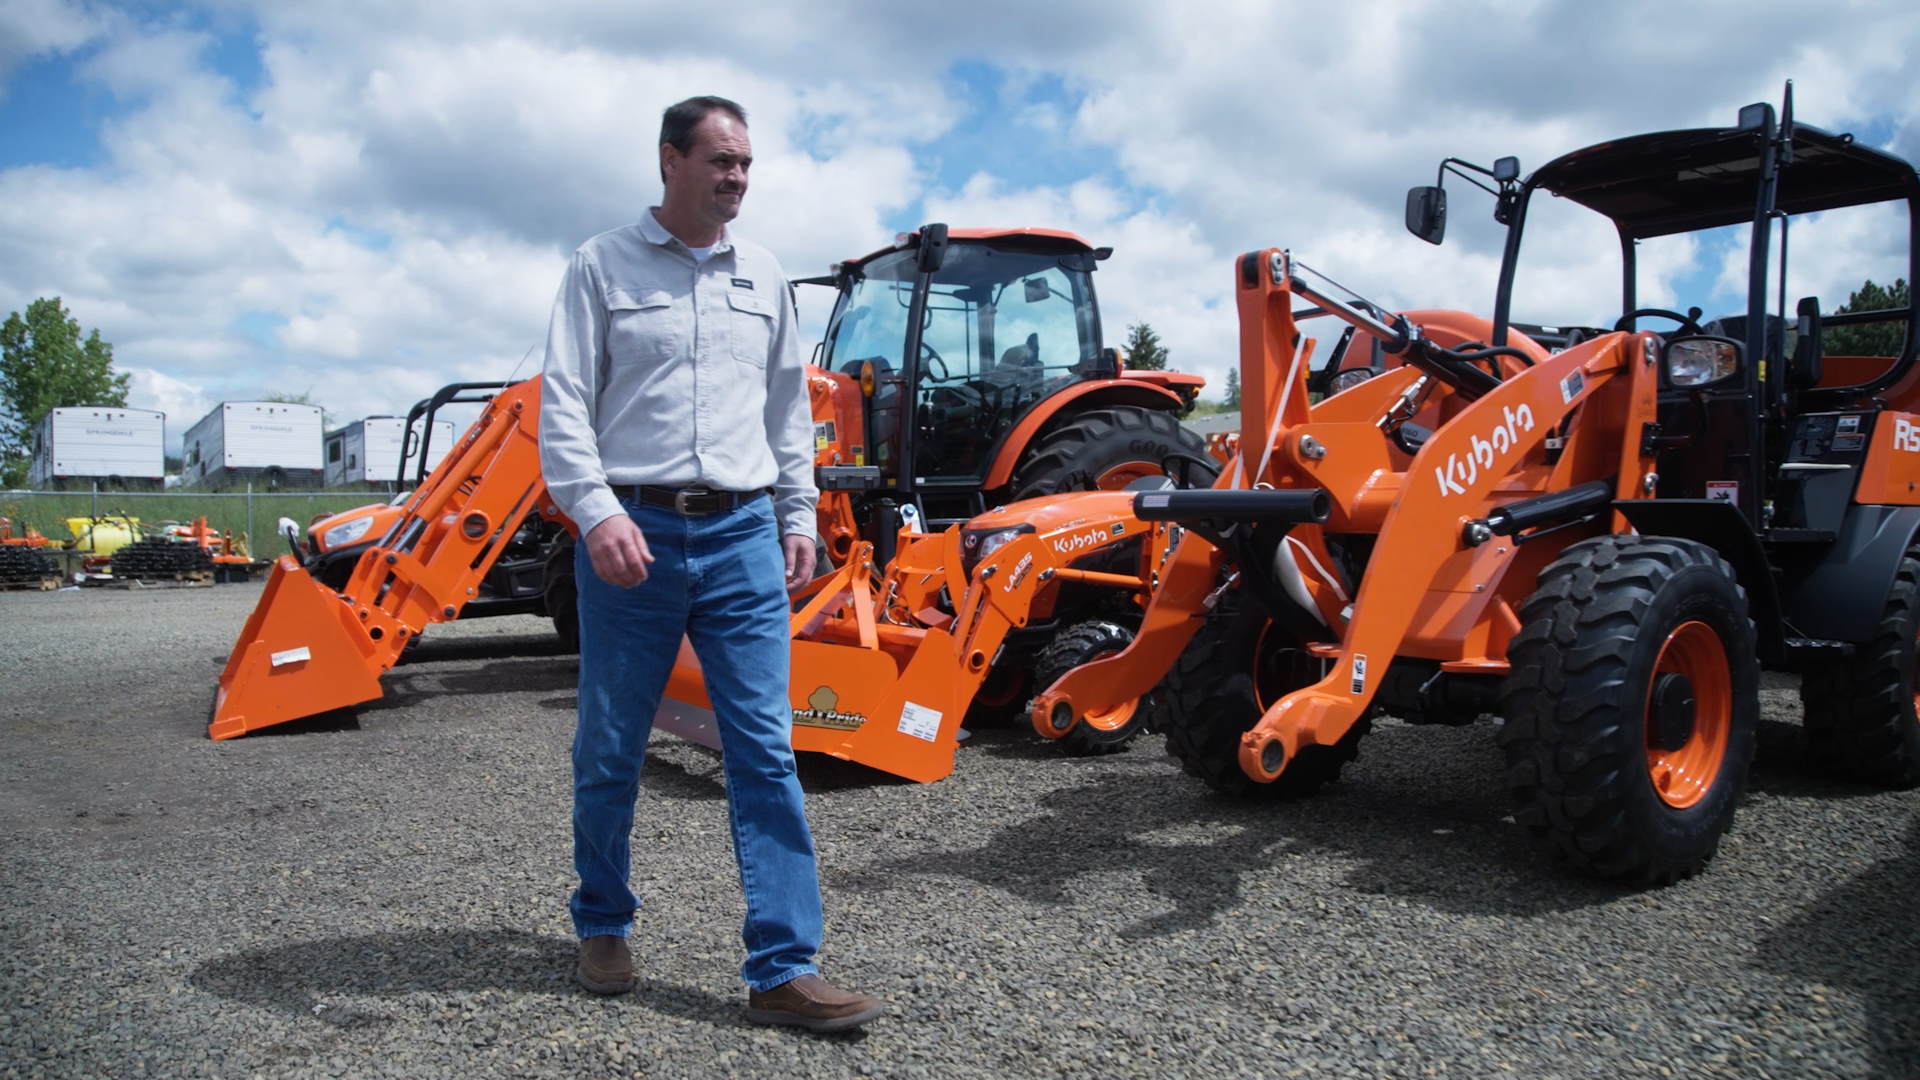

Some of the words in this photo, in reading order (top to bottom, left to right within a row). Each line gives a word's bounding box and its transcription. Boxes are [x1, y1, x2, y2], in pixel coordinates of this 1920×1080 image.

[86, 428, 134, 437] SPRINGDALE
[1435, 403, 1534, 497] Kubota
[1053, 528, 1108, 553] Kubota
[1003, 551, 1033, 592] LA435
